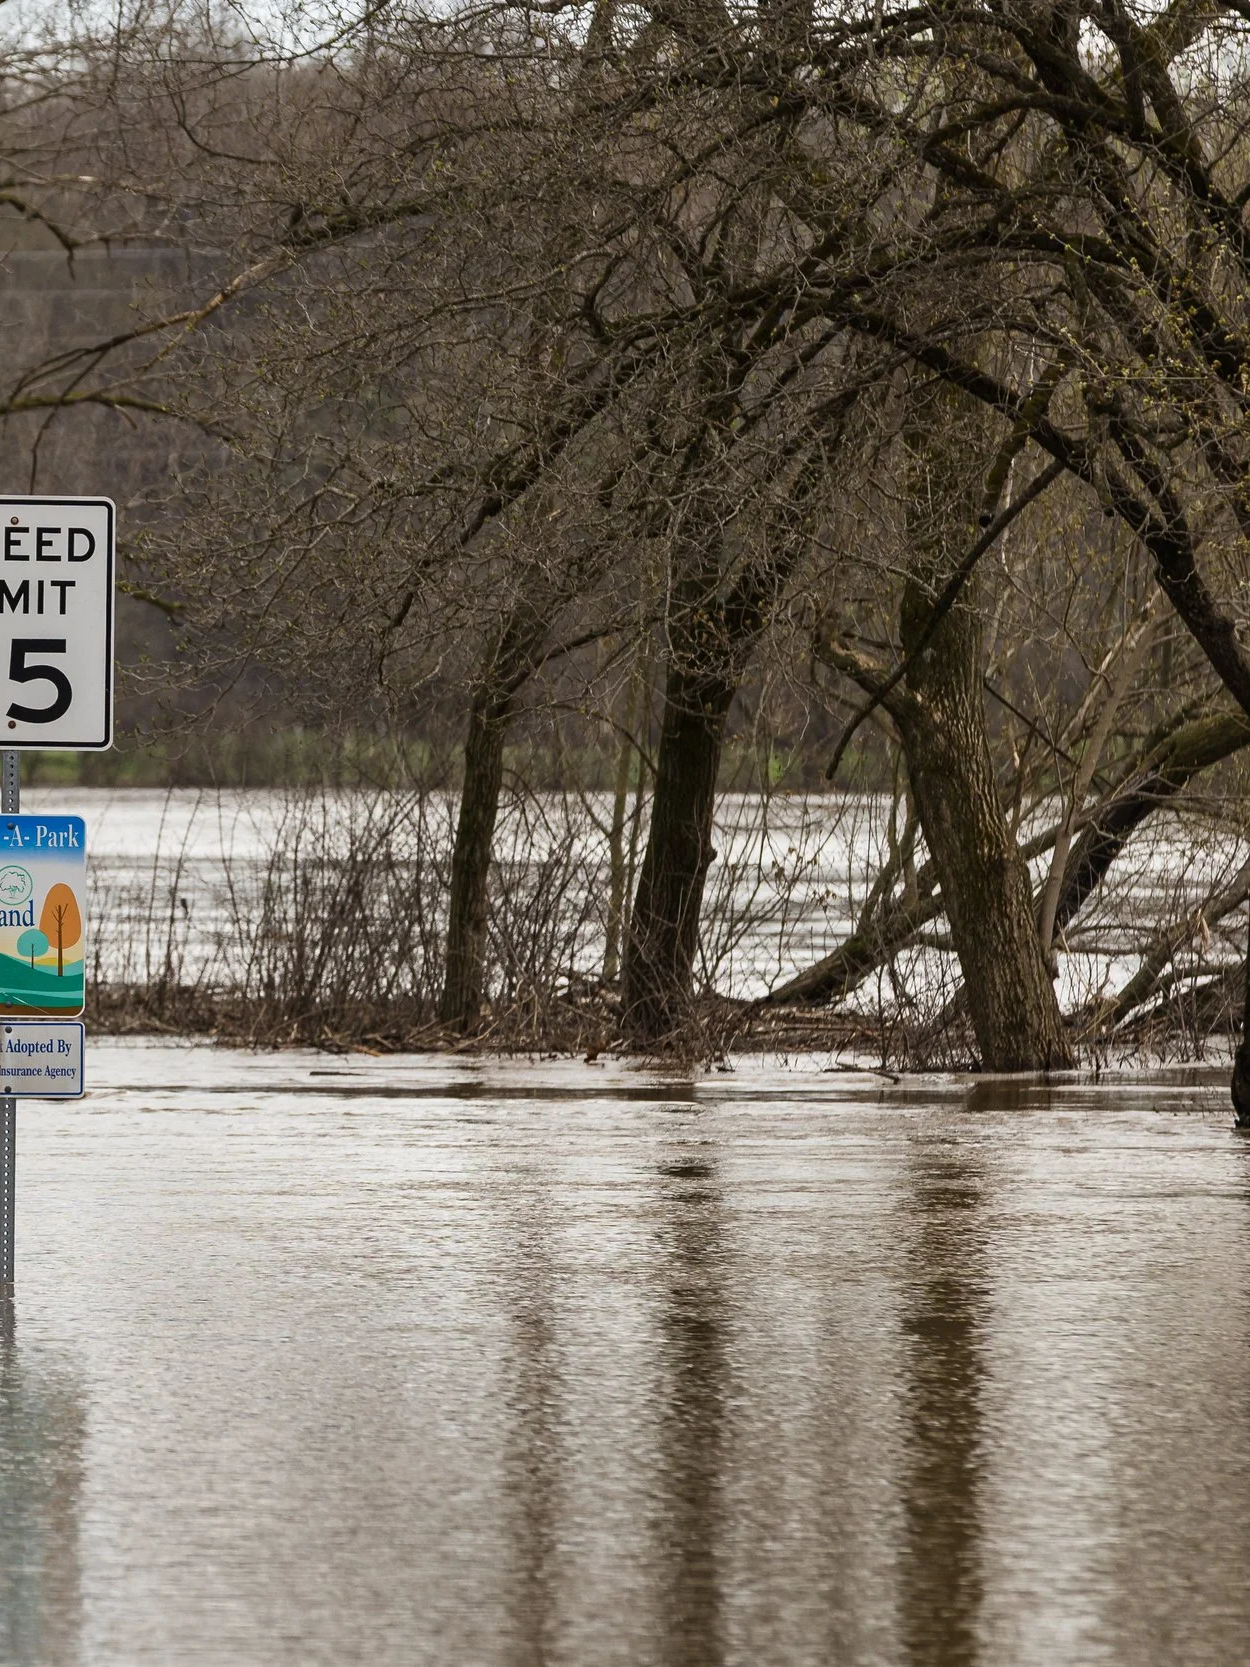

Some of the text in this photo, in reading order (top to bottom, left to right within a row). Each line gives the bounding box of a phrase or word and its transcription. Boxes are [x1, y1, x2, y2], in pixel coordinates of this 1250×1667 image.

[35, 823, 79, 848] Park
[5, 1039, 54, 1057] Adopted
[57, 1039, 72, 1057] By
[44, 1065, 77, 1079] Agency
